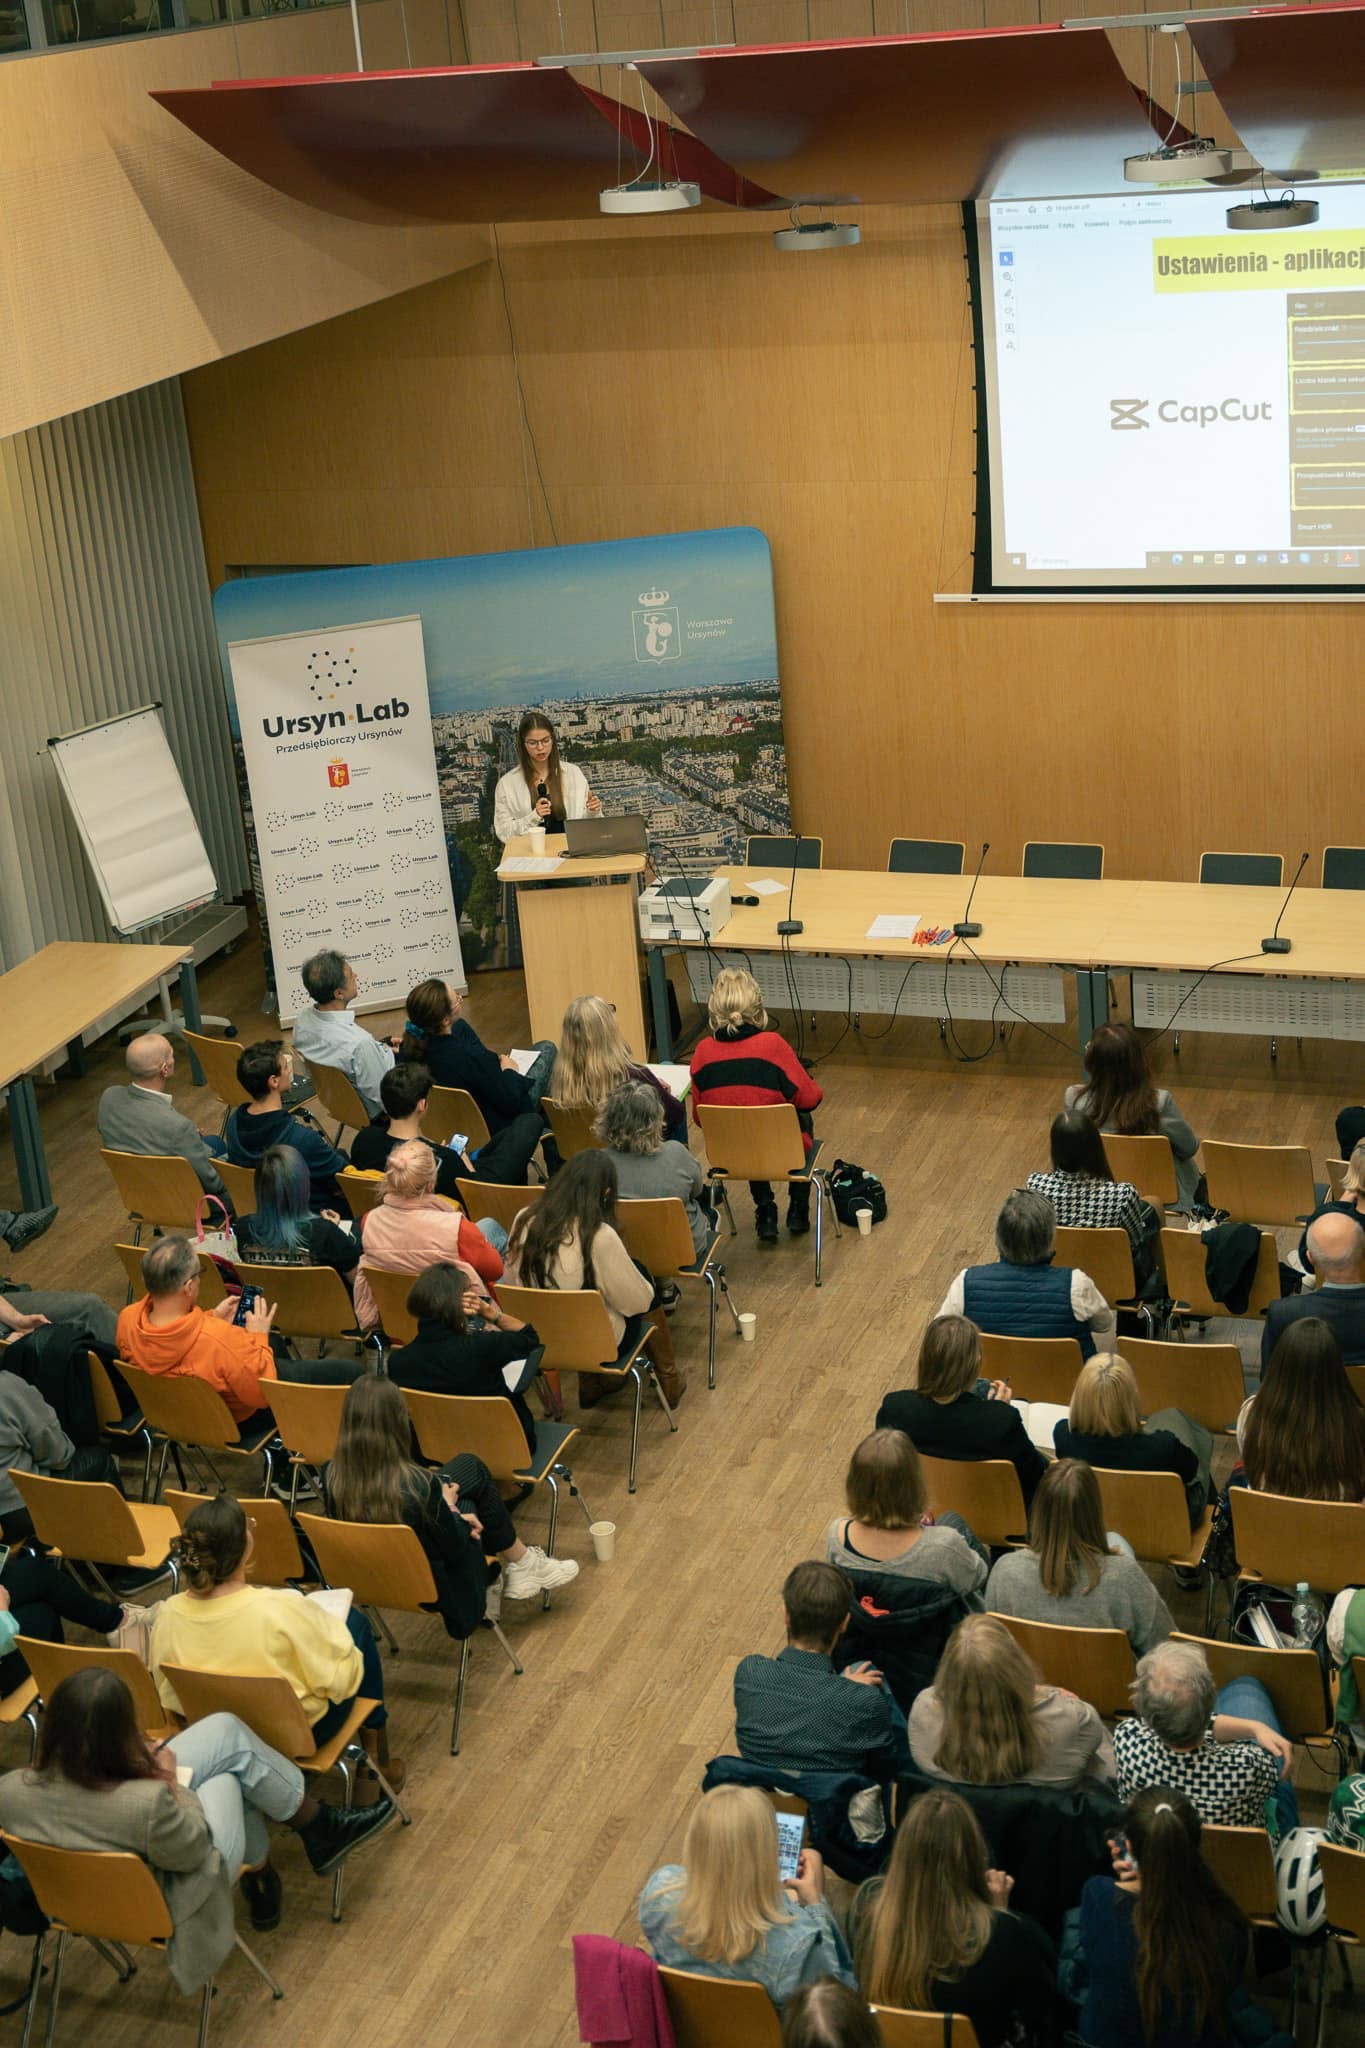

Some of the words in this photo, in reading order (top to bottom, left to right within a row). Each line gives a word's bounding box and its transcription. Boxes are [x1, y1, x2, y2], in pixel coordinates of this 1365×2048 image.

[1157, 252, 1268, 276] Ustawienia
[1157, 398, 1272, 428] CapCut
[687, 616, 733, 629] Warszawa
[687, 628, 726, 640] Ursynów
[262, 709, 346, 738] Ursyn
[355, 697, 410, 724] Lab
[276, 733, 357, 754] Przedsiębiorczy
[358, 727, 403, 742] Ursynów
